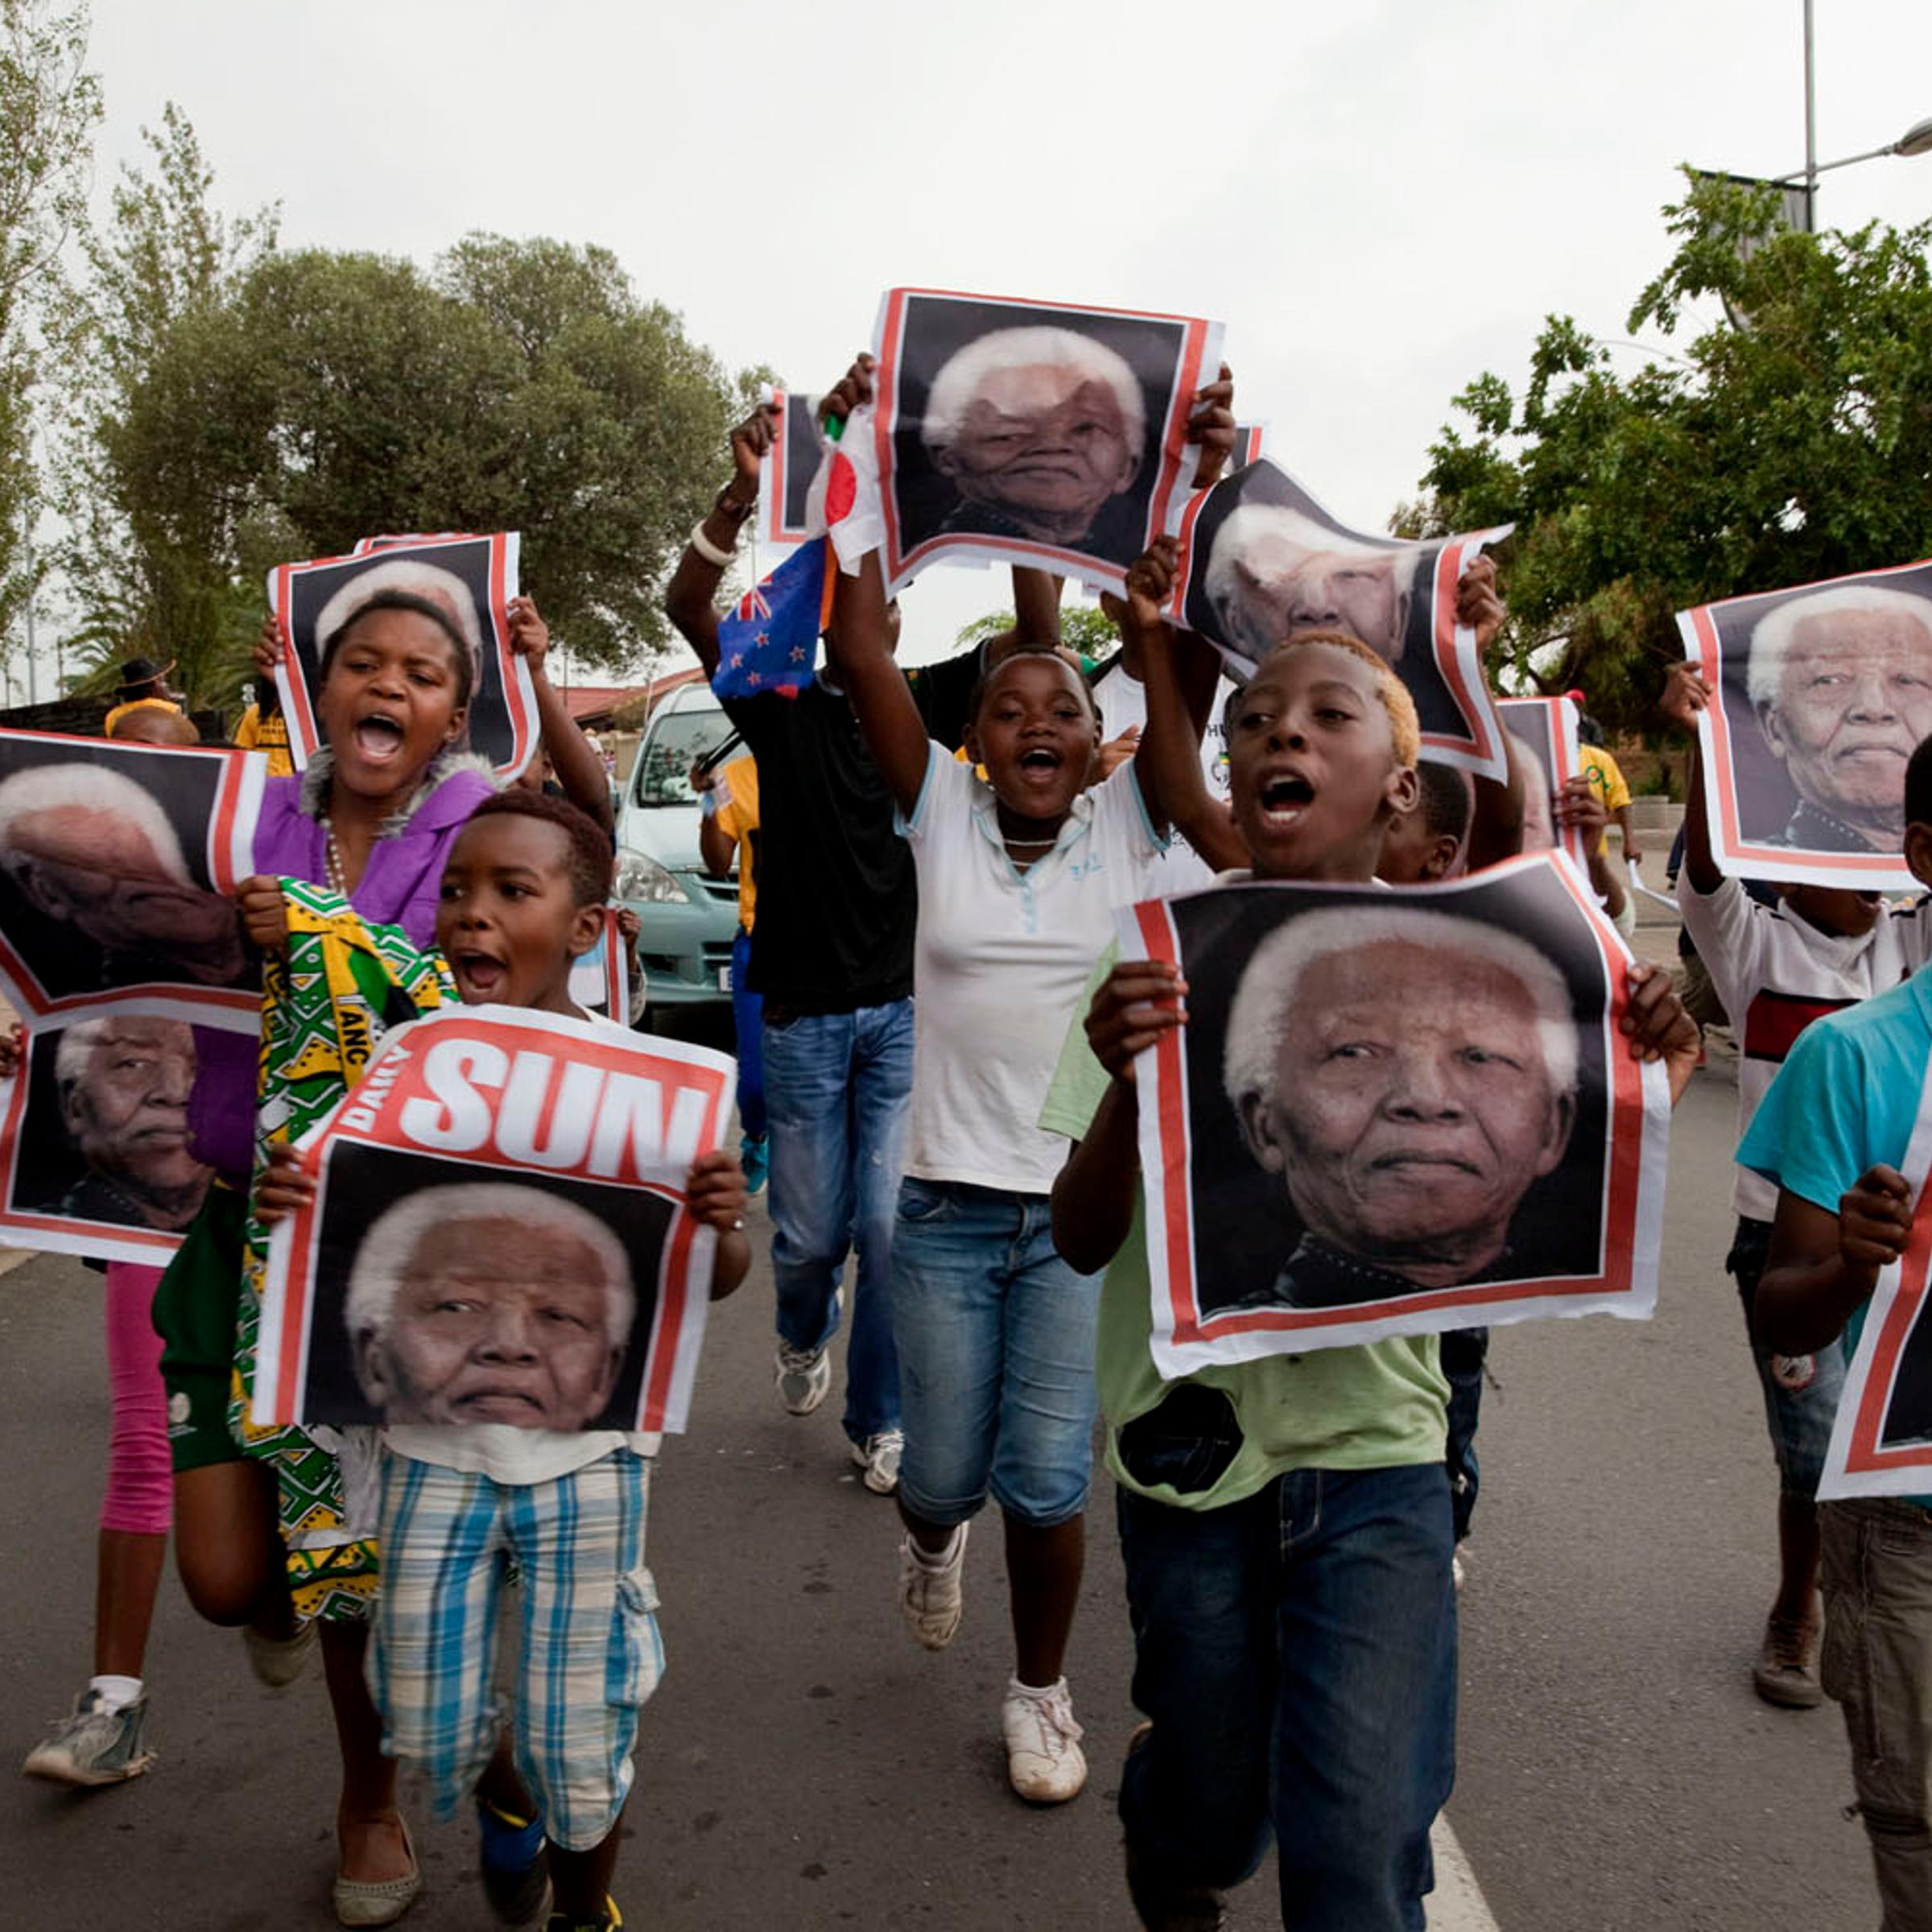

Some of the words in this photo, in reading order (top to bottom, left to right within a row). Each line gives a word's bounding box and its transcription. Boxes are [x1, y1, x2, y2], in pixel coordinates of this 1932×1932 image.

[340, 1009, 370, 1065] ANC
[339, 1045, 413, 1131] DAILY
[399, 1038, 710, 1192] SUN
